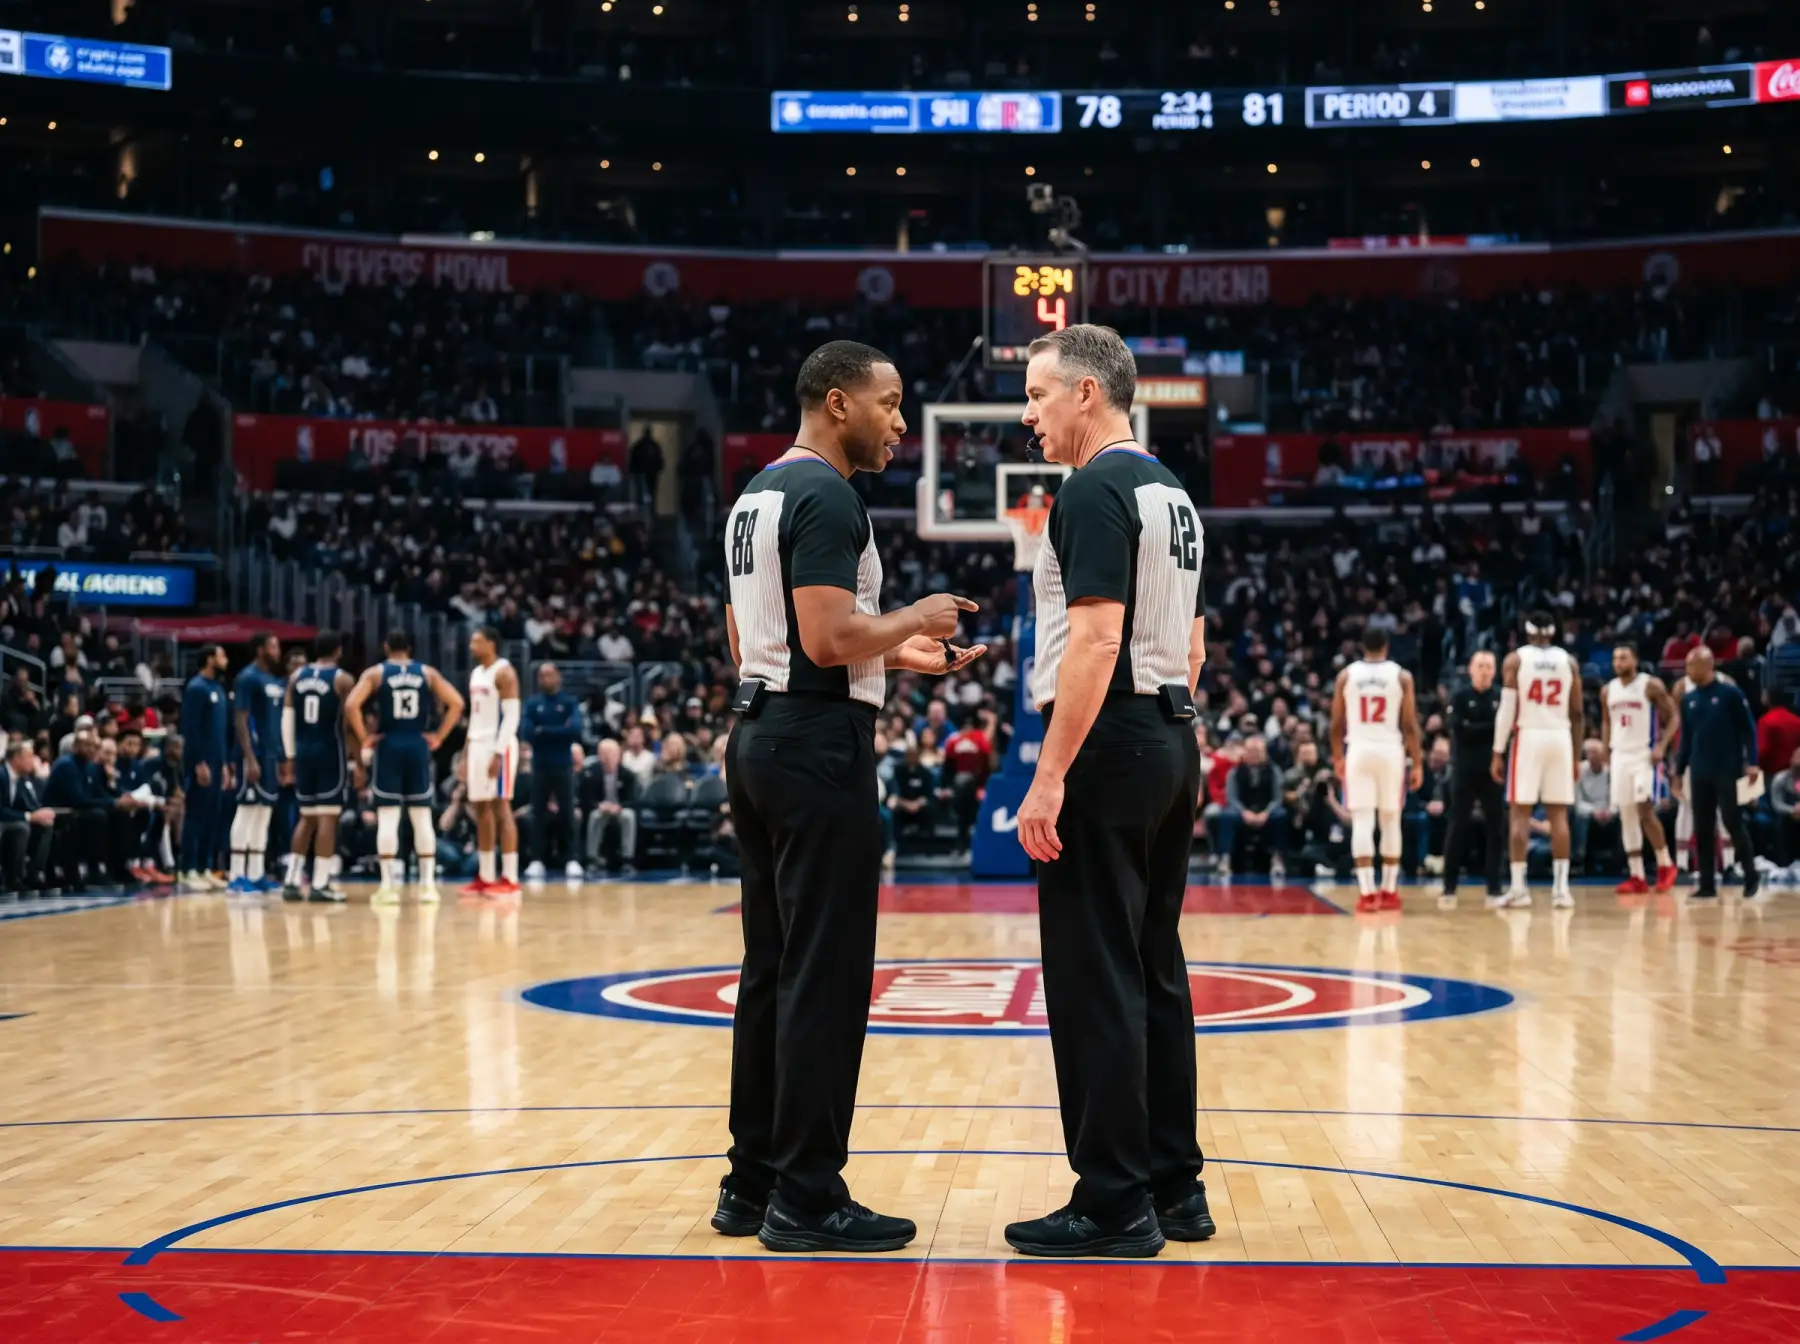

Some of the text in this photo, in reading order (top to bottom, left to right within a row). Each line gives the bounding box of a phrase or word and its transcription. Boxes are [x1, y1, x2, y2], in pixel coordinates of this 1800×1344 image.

[1076, 95, 1123, 128] 78
[1160, 91, 1213, 114] 2:34
[1242, 92, 1284, 126] 81
[1323, 91, 1437, 120] PERIOD 4
[1012, 265, 1074, 297] 2:34
[1107, 264, 1171, 305] CITY
[1177, 263, 1271, 304] ARENA
[1036, 297, 1067, 331] 4
[732, 508, 760, 577] 88
[1167, 501, 1198, 572] 42
[391, 689, 421, 720] 13
[1526, 679, 1564, 706] 42
[303, 694, 321, 724] 0
[1359, 696, 1388, 723] 12
